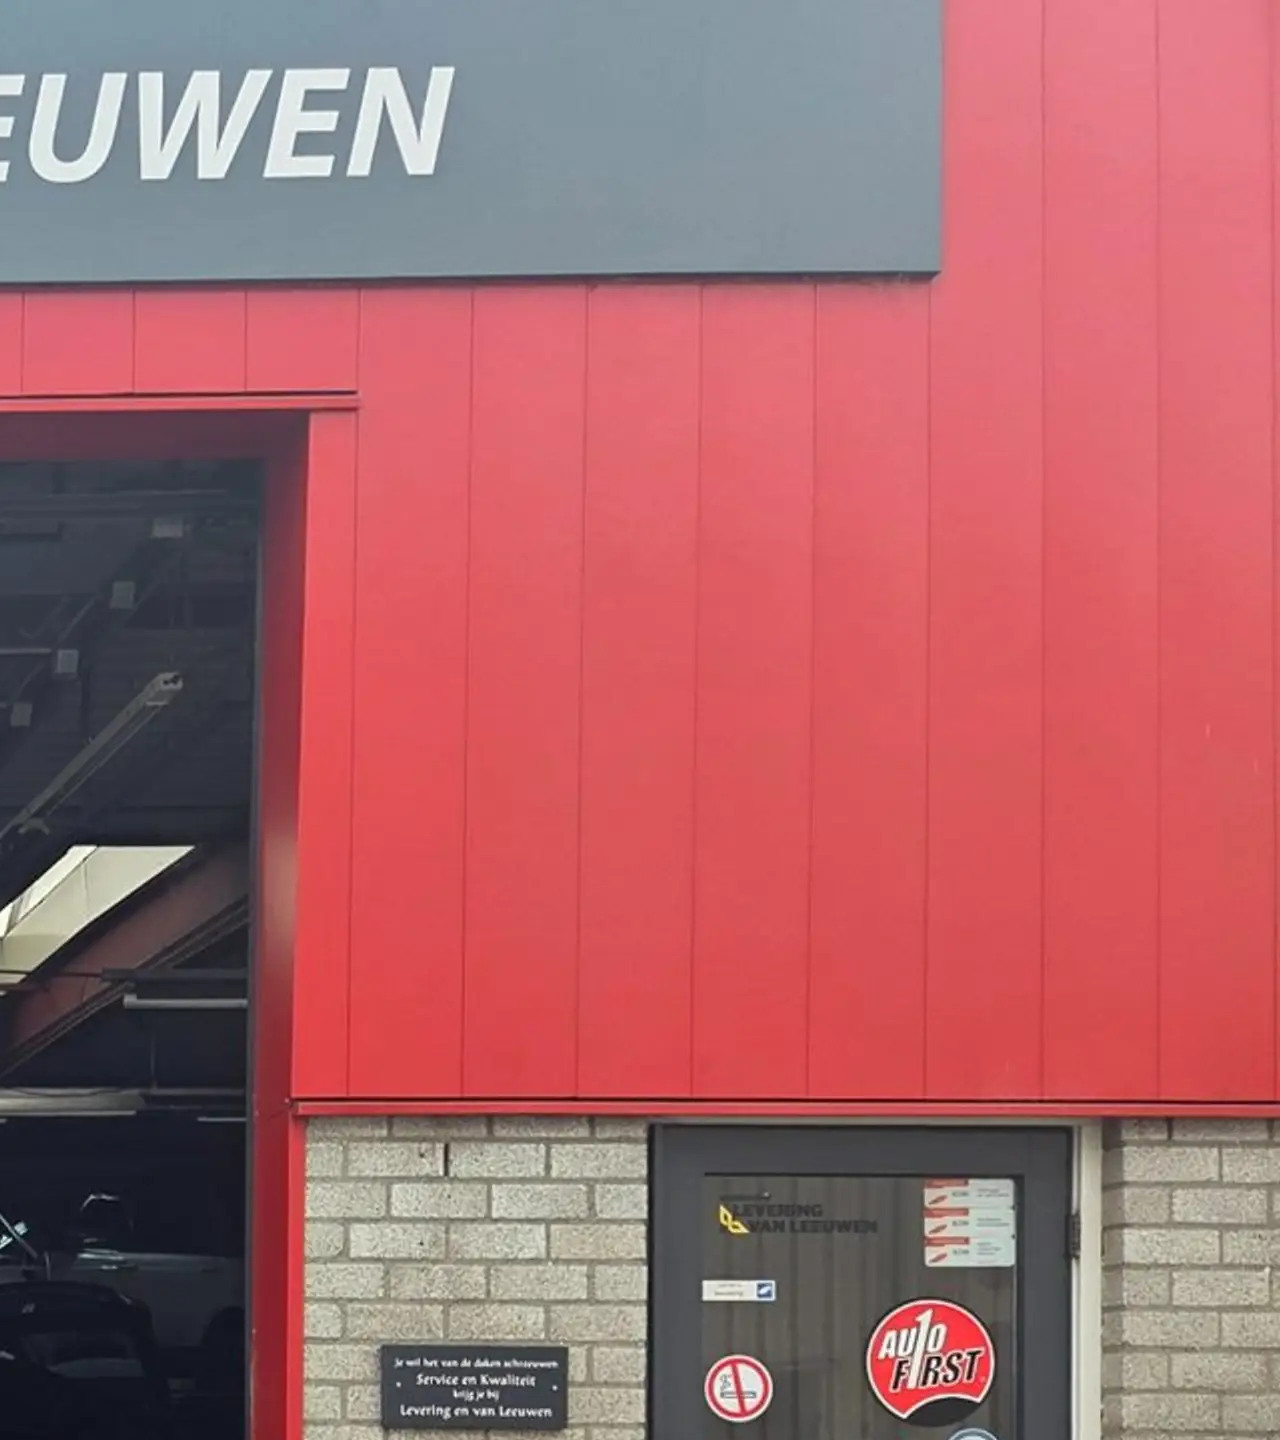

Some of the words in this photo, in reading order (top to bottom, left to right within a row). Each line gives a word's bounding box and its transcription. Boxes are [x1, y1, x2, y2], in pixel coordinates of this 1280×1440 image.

[416, 1373, 459, 1386] Service
[462, 1375, 477, 1386] en
[480, 1373, 536, 1387] Kwaliteit
[400, 1404, 452, 1420] Levering
[454, 1407, 470, 1418] en
[474, 1407, 496, 1418] van
[498, 1405, 553, 1418] Leeuwen
